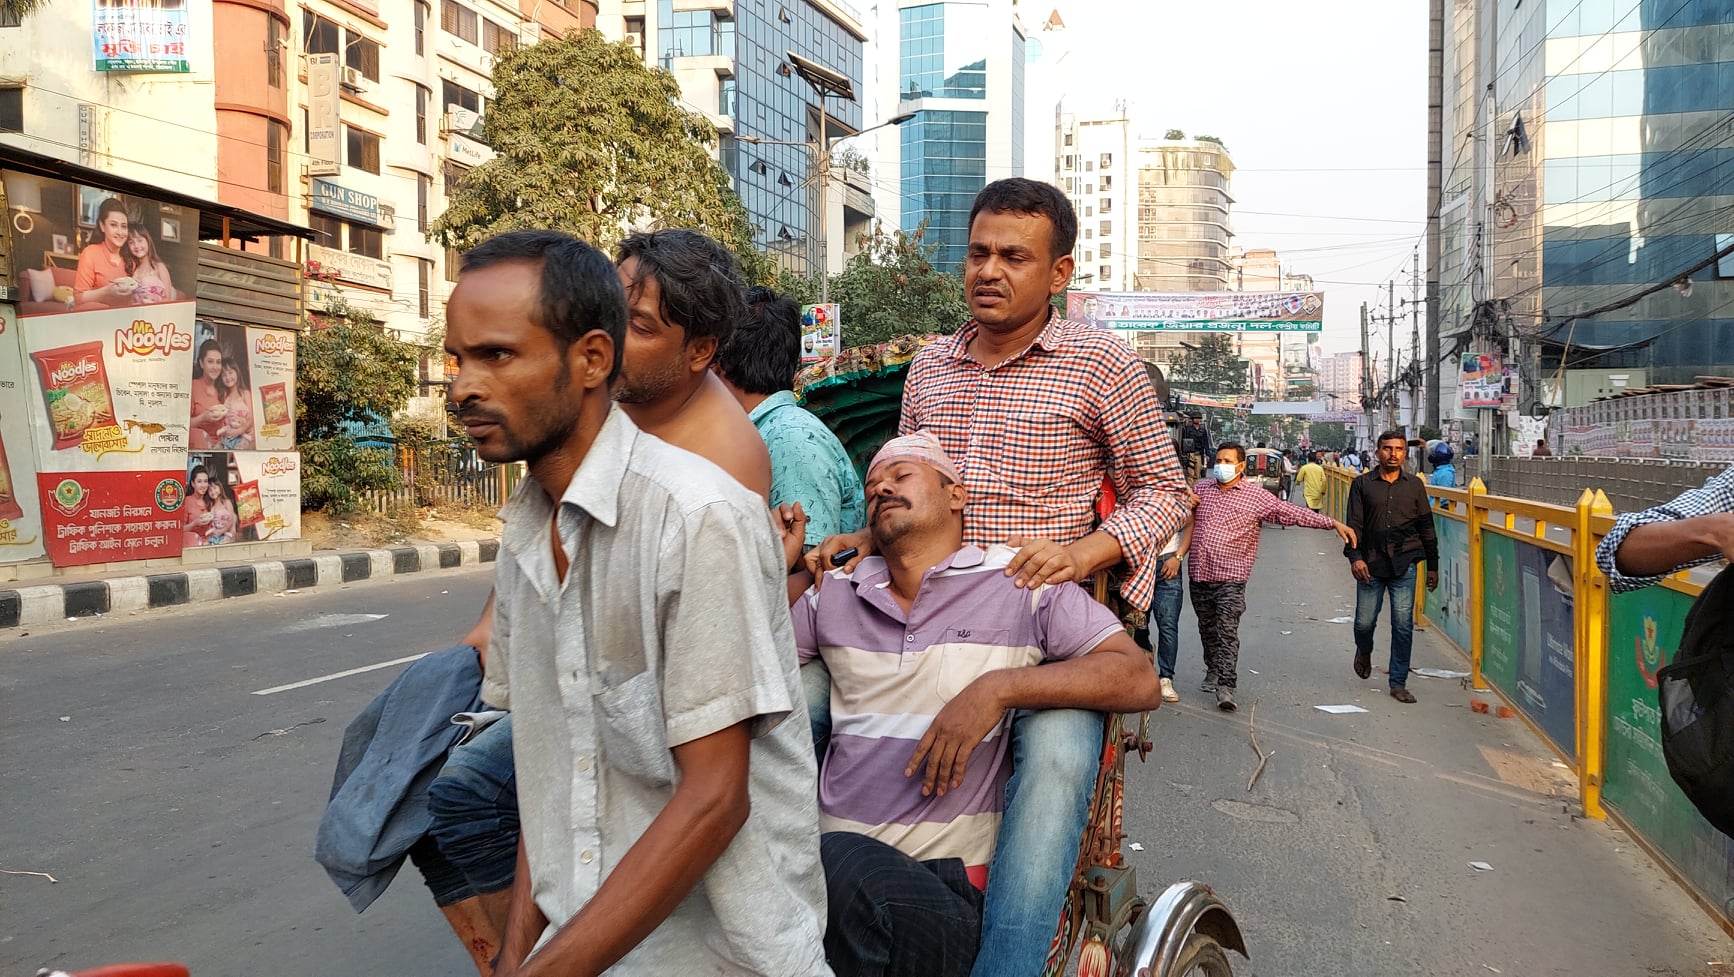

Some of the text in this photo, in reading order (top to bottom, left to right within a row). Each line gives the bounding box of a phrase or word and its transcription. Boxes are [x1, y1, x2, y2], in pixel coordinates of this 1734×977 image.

[462, 145, 480, 159] MetLife
[321, 183, 377, 210] GUN SHOP
[132, 320, 154, 333] Mr.
[115, 323, 192, 357] Noodles
[256, 336, 294, 354] Noodles
[51, 360, 98, 387] Noodles
[262, 457, 295, 476] Noodles
[89, 505, 152, 519] যানজট নিরসনে
[57, 523, 86, 538] ট্রাফিক
[88, 521, 121, 537] পুলিশকে
[124, 521, 152, 533] সহায়তা
[69, 538, 98, 554] ট্রাফিক
[98, 537, 121, 549] আইন
[124, 537, 142, 548] মেনে
